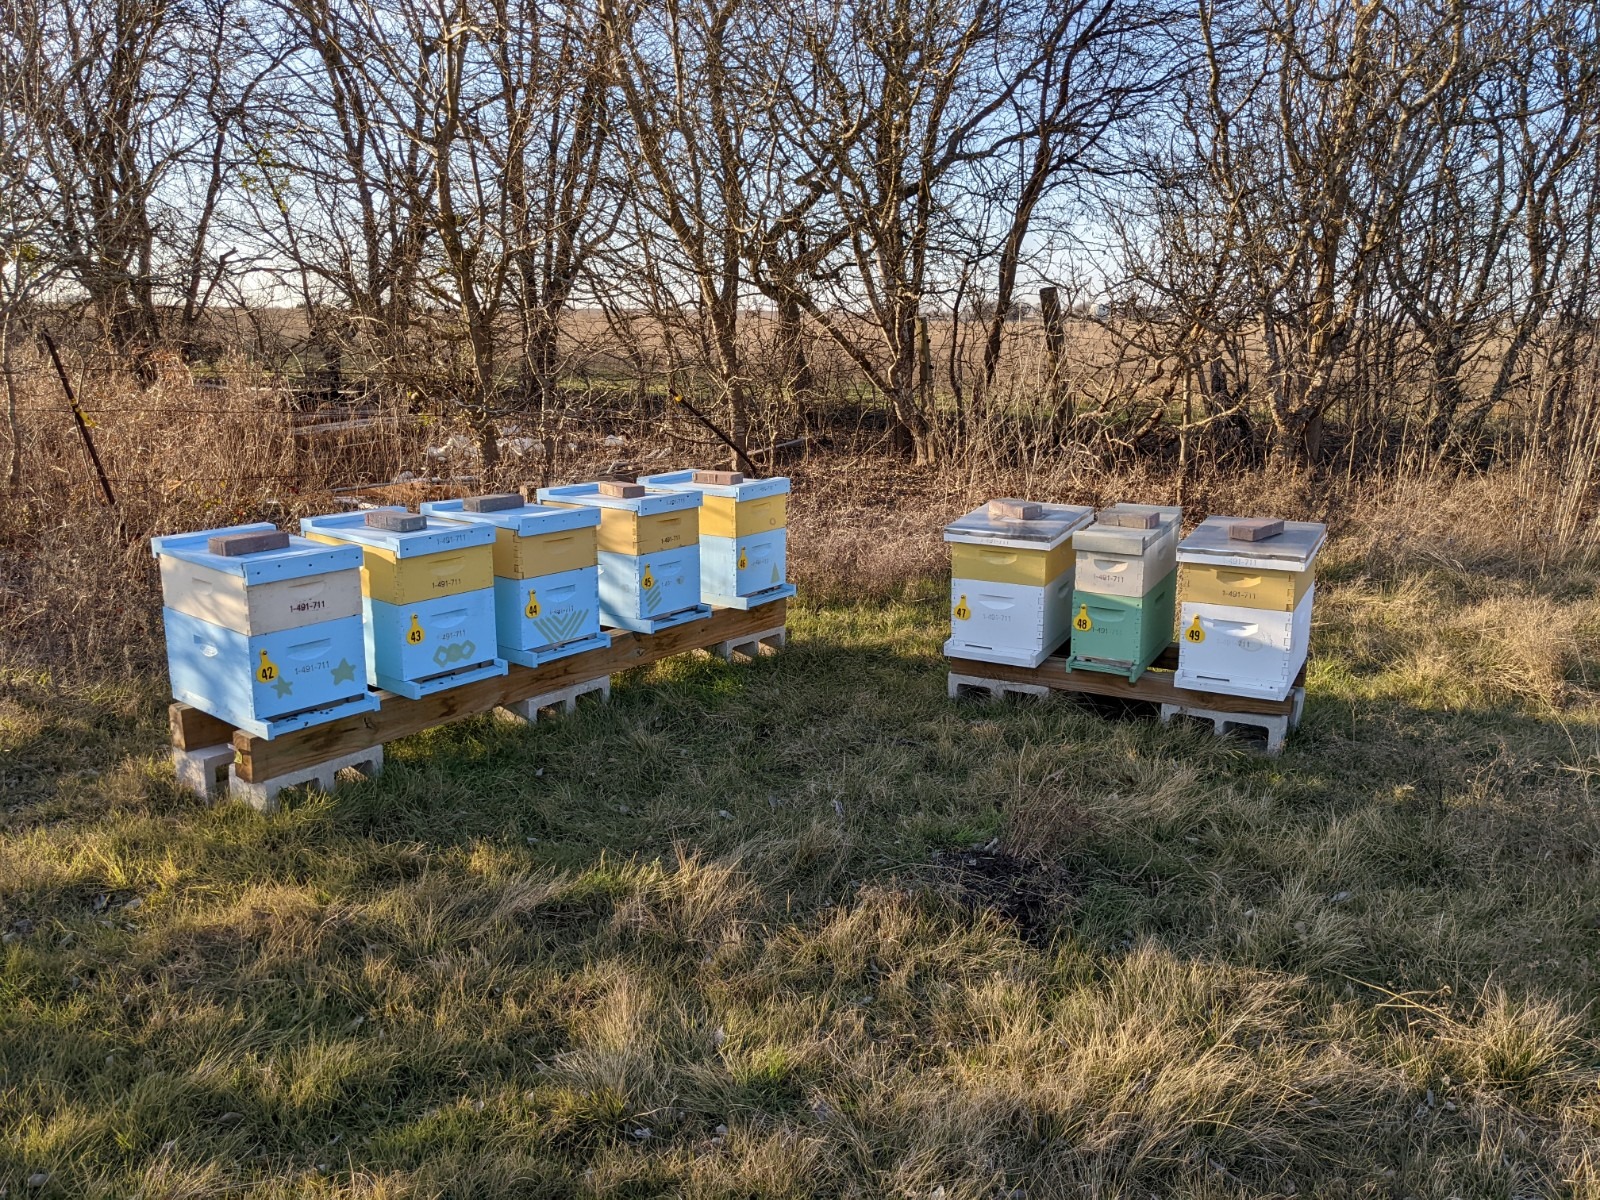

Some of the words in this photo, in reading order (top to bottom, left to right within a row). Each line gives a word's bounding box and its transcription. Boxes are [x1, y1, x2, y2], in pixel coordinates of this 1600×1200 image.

[432, 578, 461, 589] 1-491-711
[644, 577, 652, 588] 45
[1222, 590, 1256, 600] 1-491-711
[289, 600, 325, 613] 1-491-711
[528, 604, 537, 617] 44
[956, 607, 966, 618] 47
[1077, 618, 1088, 630] 48
[410, 630, 421, 643] 43
[1189, 629, 1200, 641] 49
[261, 666, 274, 681] 42
[294, 660, 330, 675] 1-491-711
